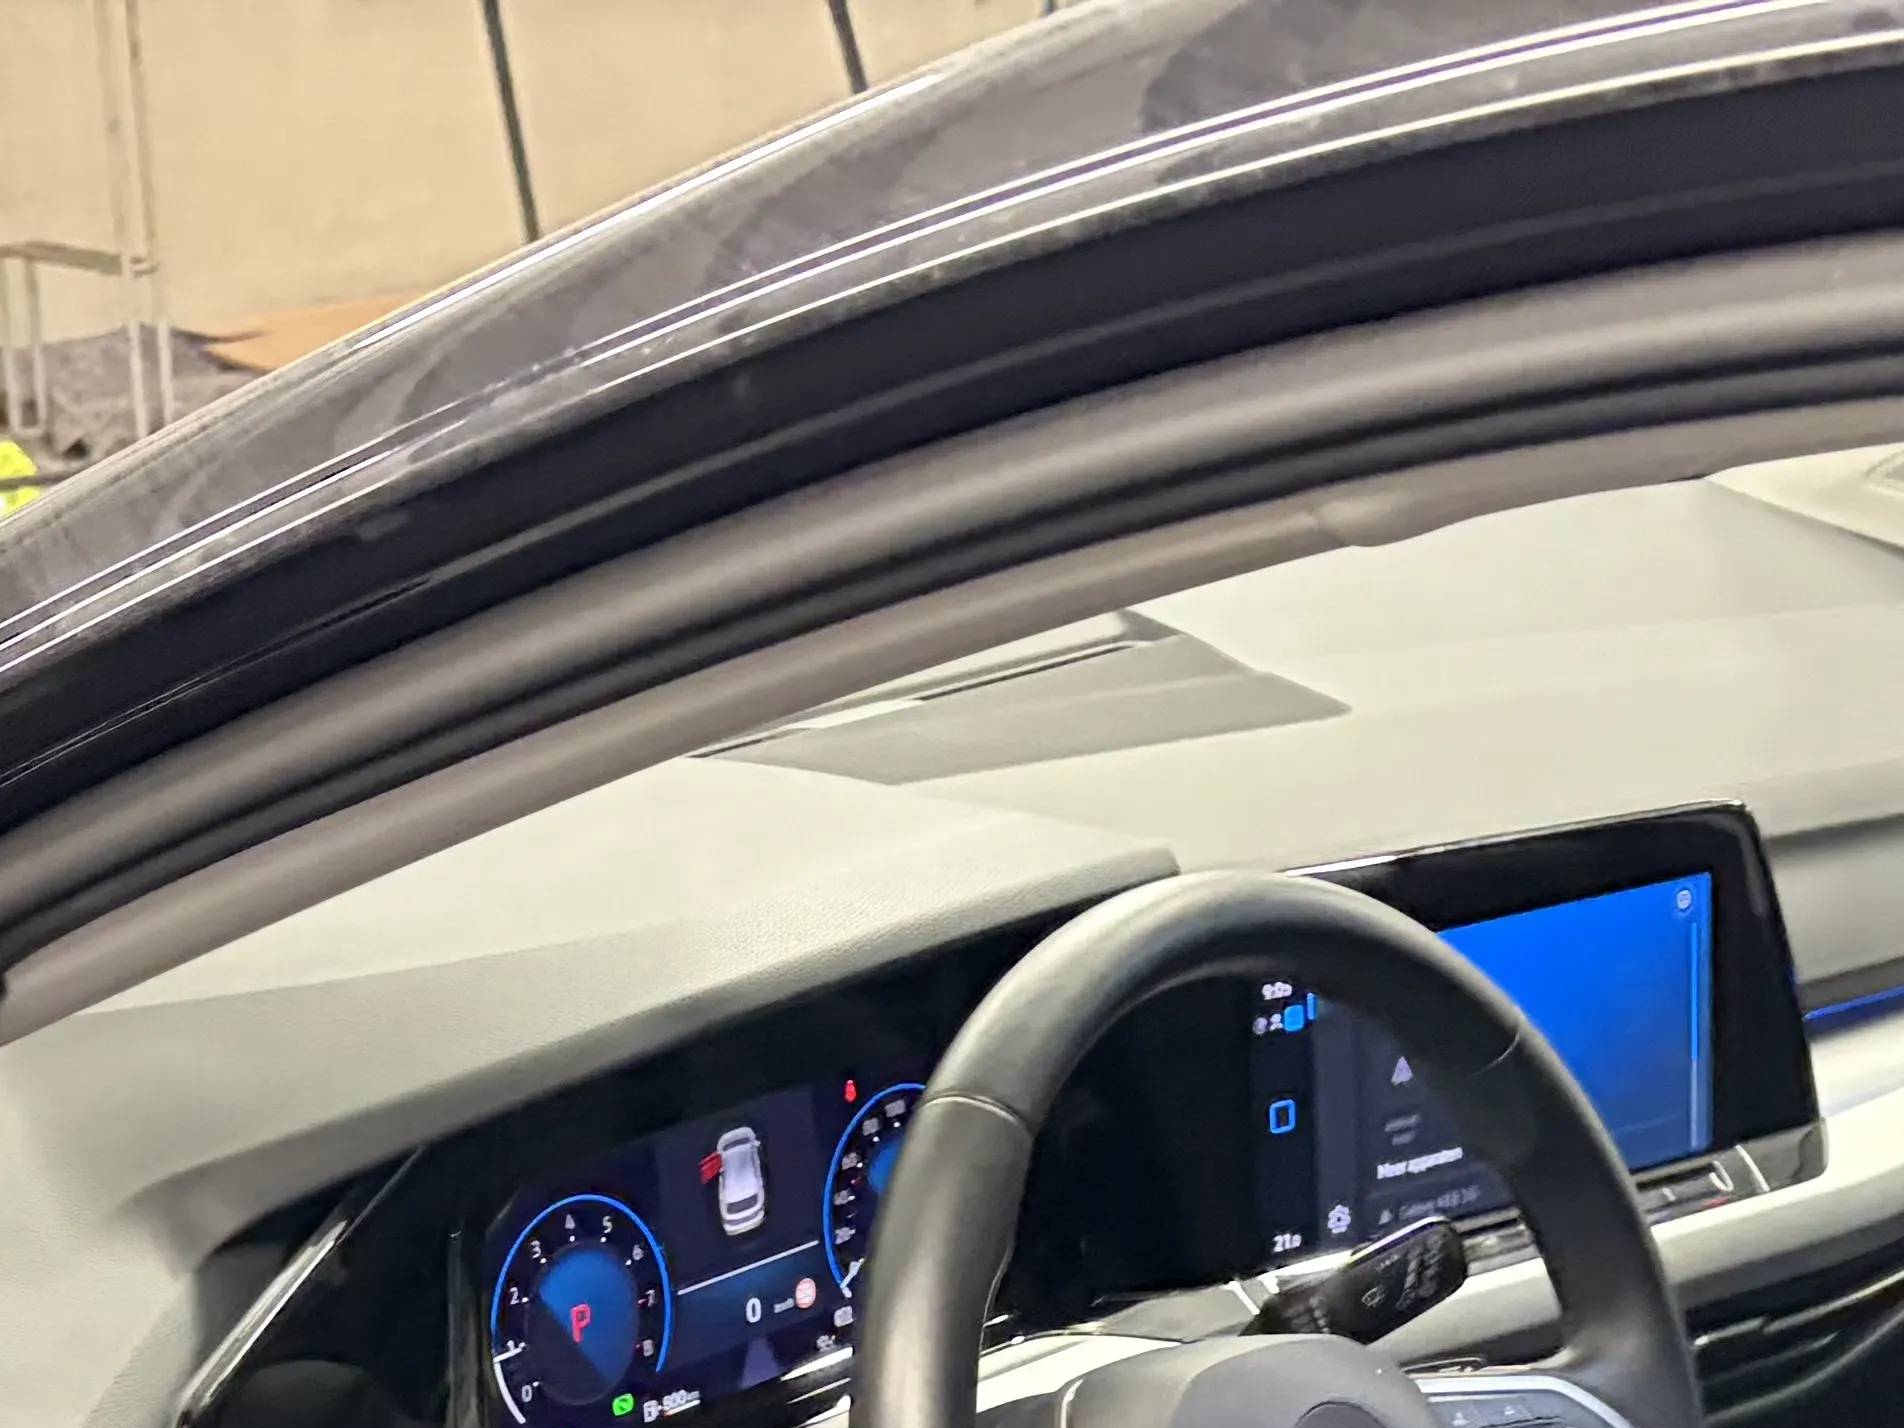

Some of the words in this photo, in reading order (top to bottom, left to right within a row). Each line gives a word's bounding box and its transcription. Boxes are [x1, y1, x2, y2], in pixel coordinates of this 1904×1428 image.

[602, 1215, 613, 1233] 5
[530, 1240, 541, 1259] 3
[509, 1286, 519, 1305] 2
[746, 1297, 762, 1324] 0
[570, 1304, 591, 1343] P
